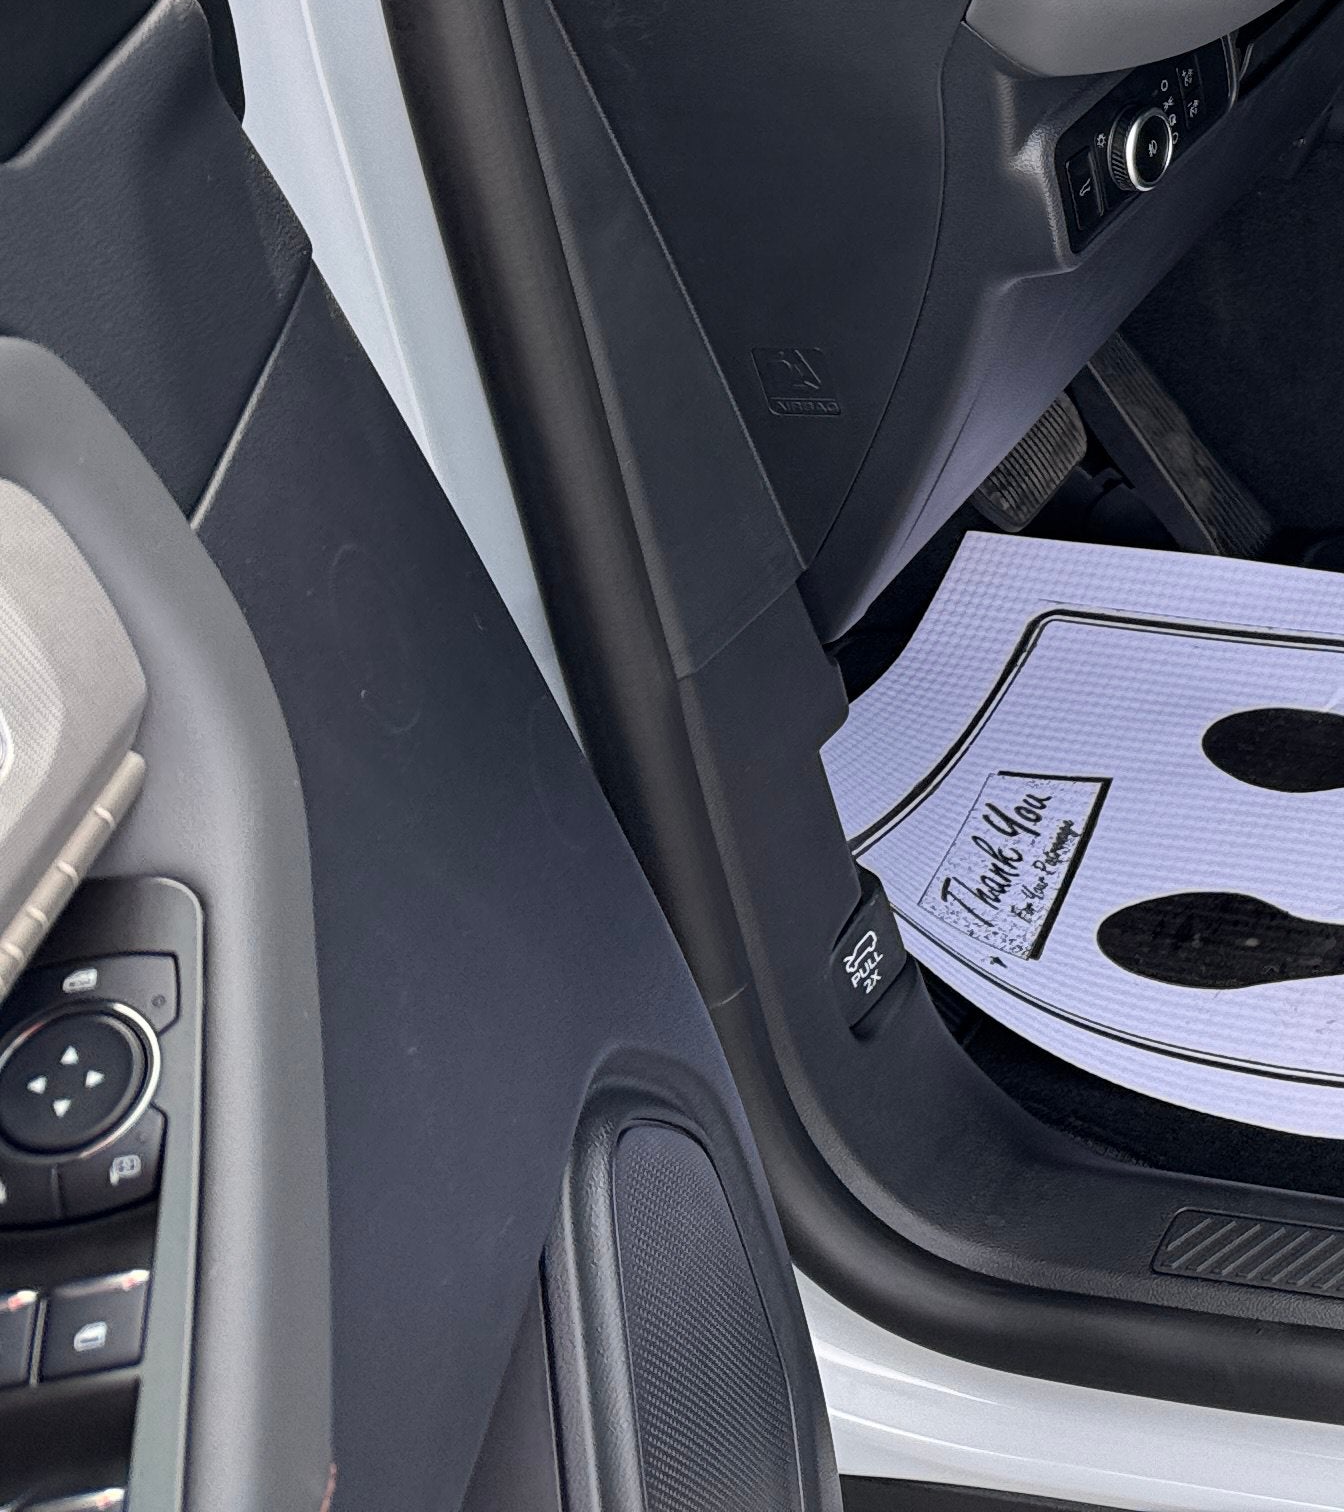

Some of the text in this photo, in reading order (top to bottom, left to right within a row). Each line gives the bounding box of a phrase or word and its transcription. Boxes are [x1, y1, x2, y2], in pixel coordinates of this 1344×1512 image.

[941, 794, 1053, 927] Thank You
[850, 951, 883, 988] PULL
[863, 968, 882, 994] 2X
